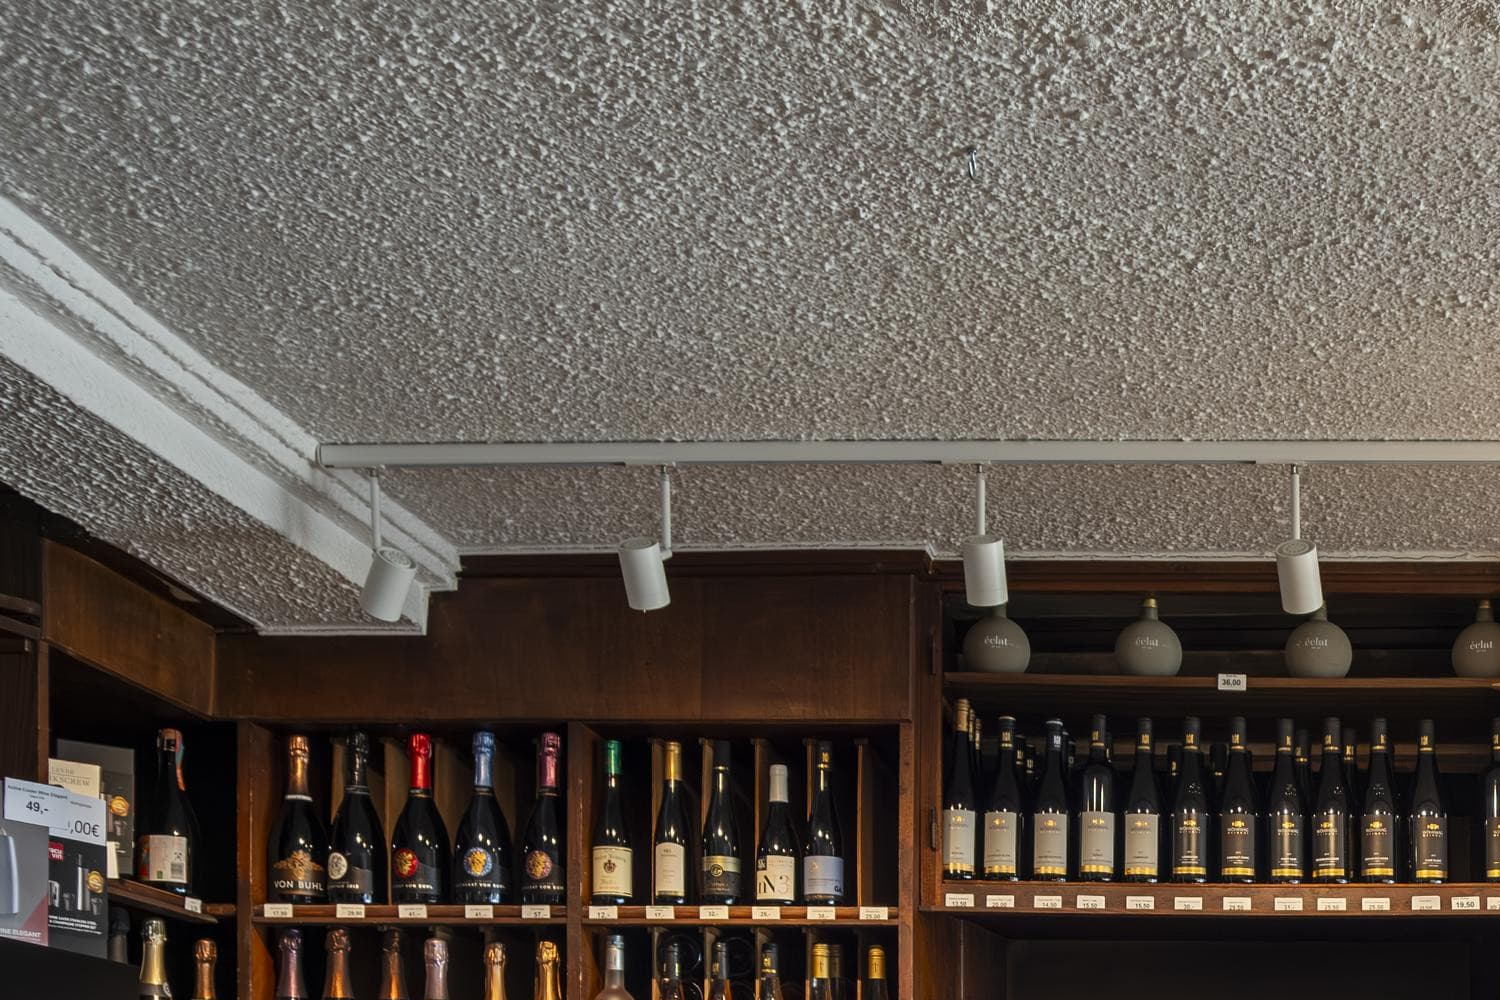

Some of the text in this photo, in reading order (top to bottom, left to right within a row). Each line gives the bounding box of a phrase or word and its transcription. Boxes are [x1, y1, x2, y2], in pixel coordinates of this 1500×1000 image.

[68, 819, 100, 838] ,00€
[274, 880, 294, 890] VON
[298, 880, 324, 893] BUHL
